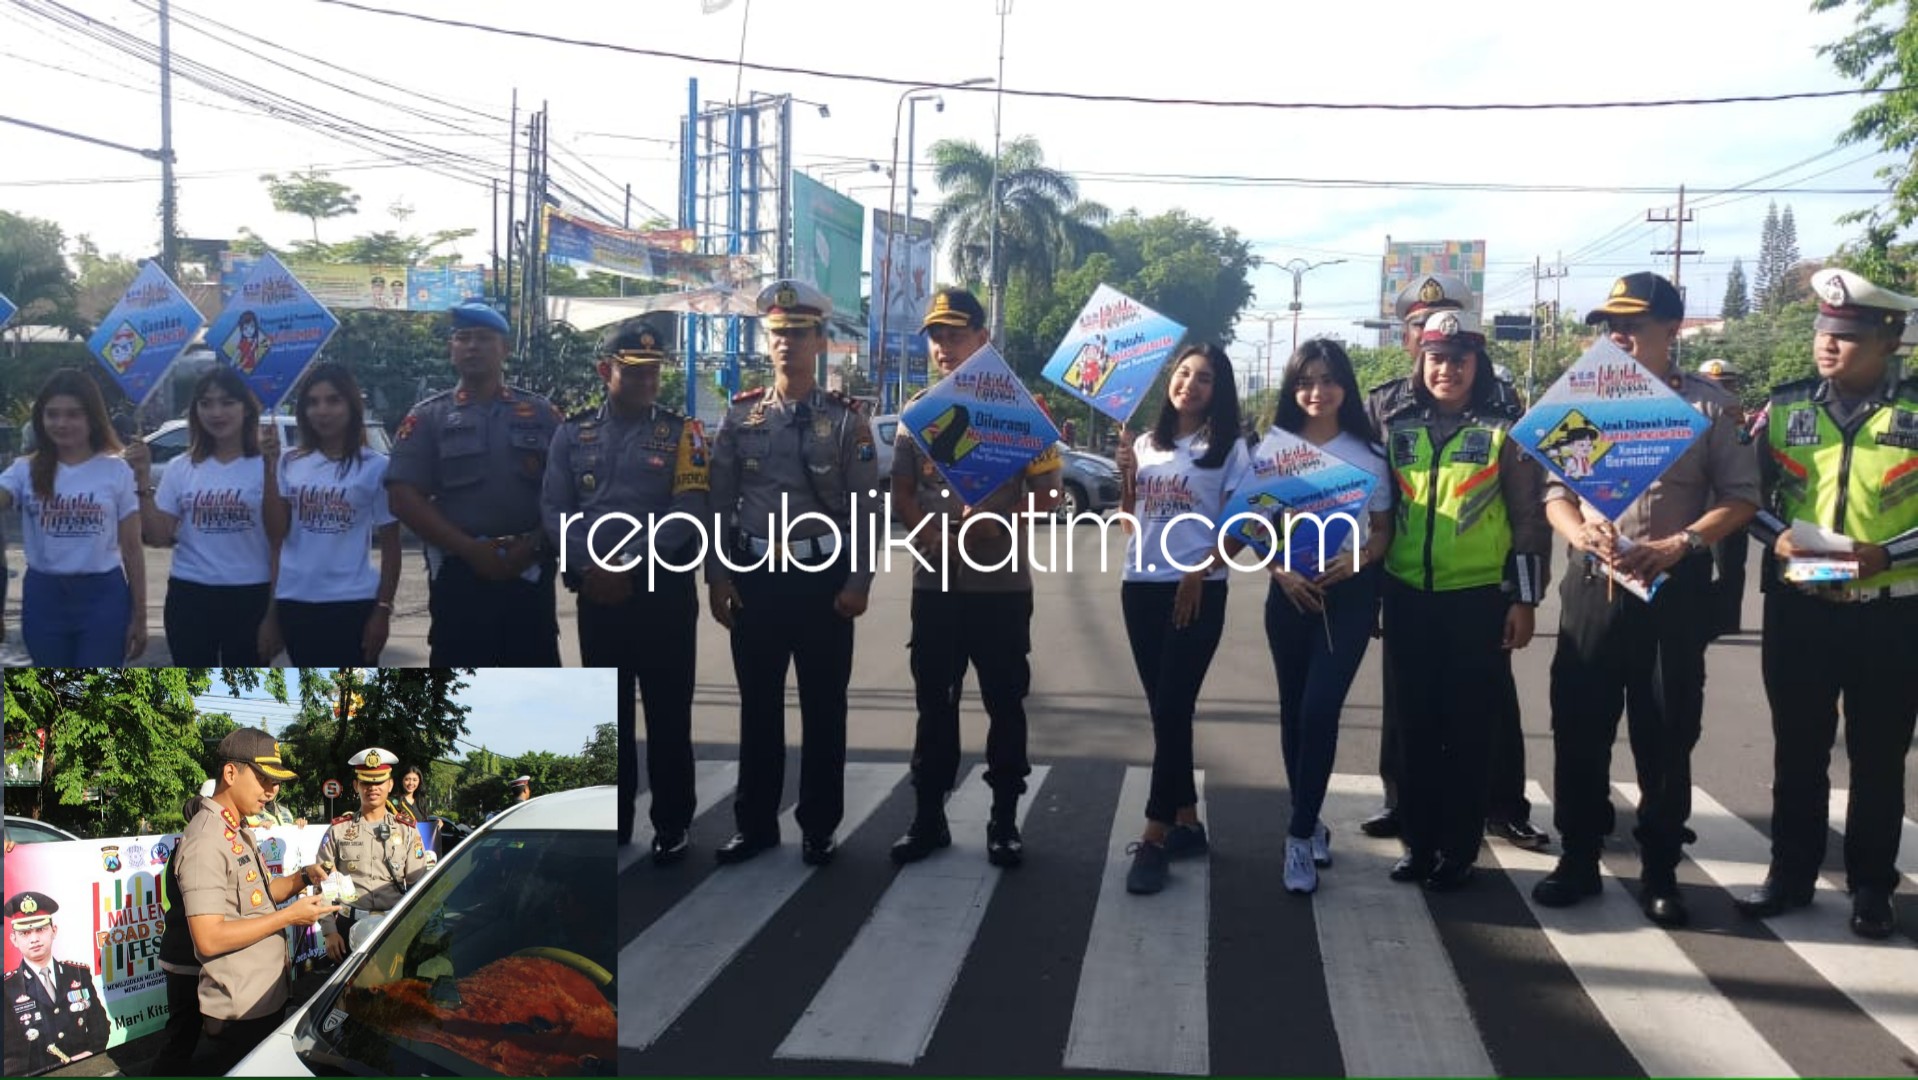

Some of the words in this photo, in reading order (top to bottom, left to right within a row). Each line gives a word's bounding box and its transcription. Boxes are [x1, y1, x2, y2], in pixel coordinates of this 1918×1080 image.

[975, 410, 1031, 435] Dilarang
[97, 922, 150, 948] ROAD
[114, 1010, 144, 1031] Mari
[147, 1002, 169, 1020] Kita
